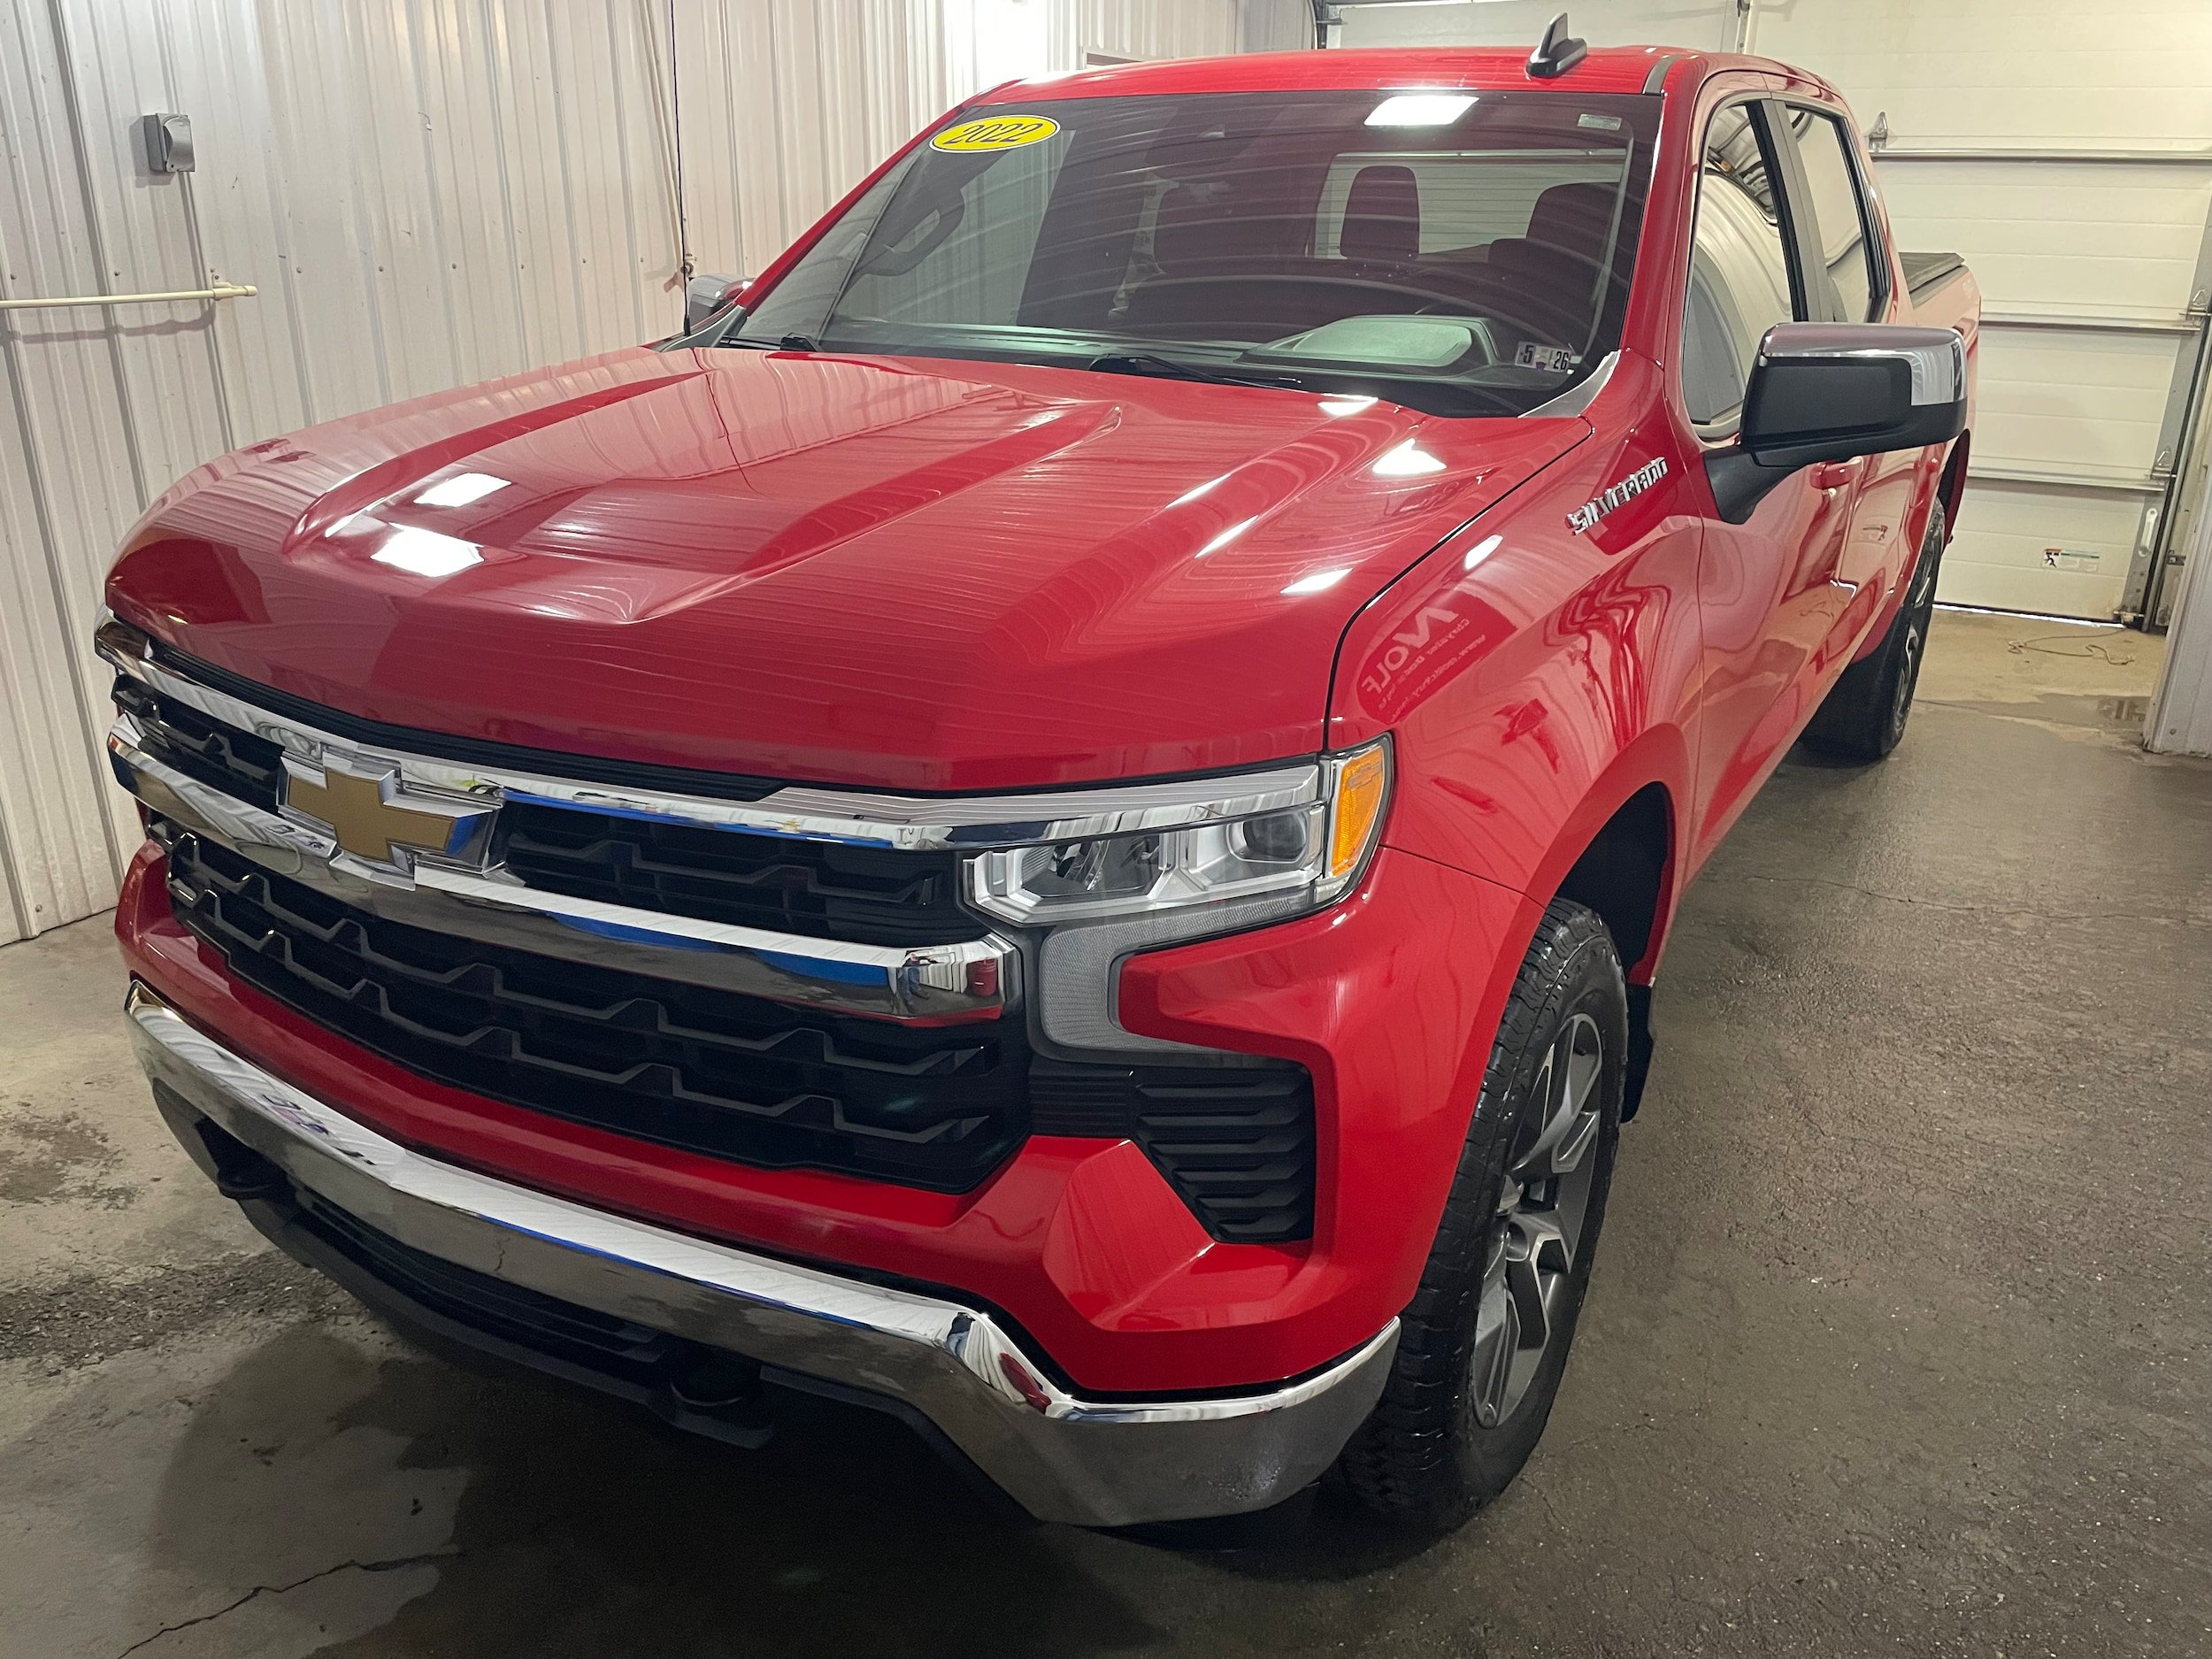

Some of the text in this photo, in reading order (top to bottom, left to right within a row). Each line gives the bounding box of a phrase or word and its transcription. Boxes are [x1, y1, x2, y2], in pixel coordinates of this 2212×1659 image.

[942, 123, 1043, 144] 2022
[1523, 344, 1534, 364] 5
[1553, 350, 1569, 370] 26
[1566, 457, 1668, 535] SILVERADO
